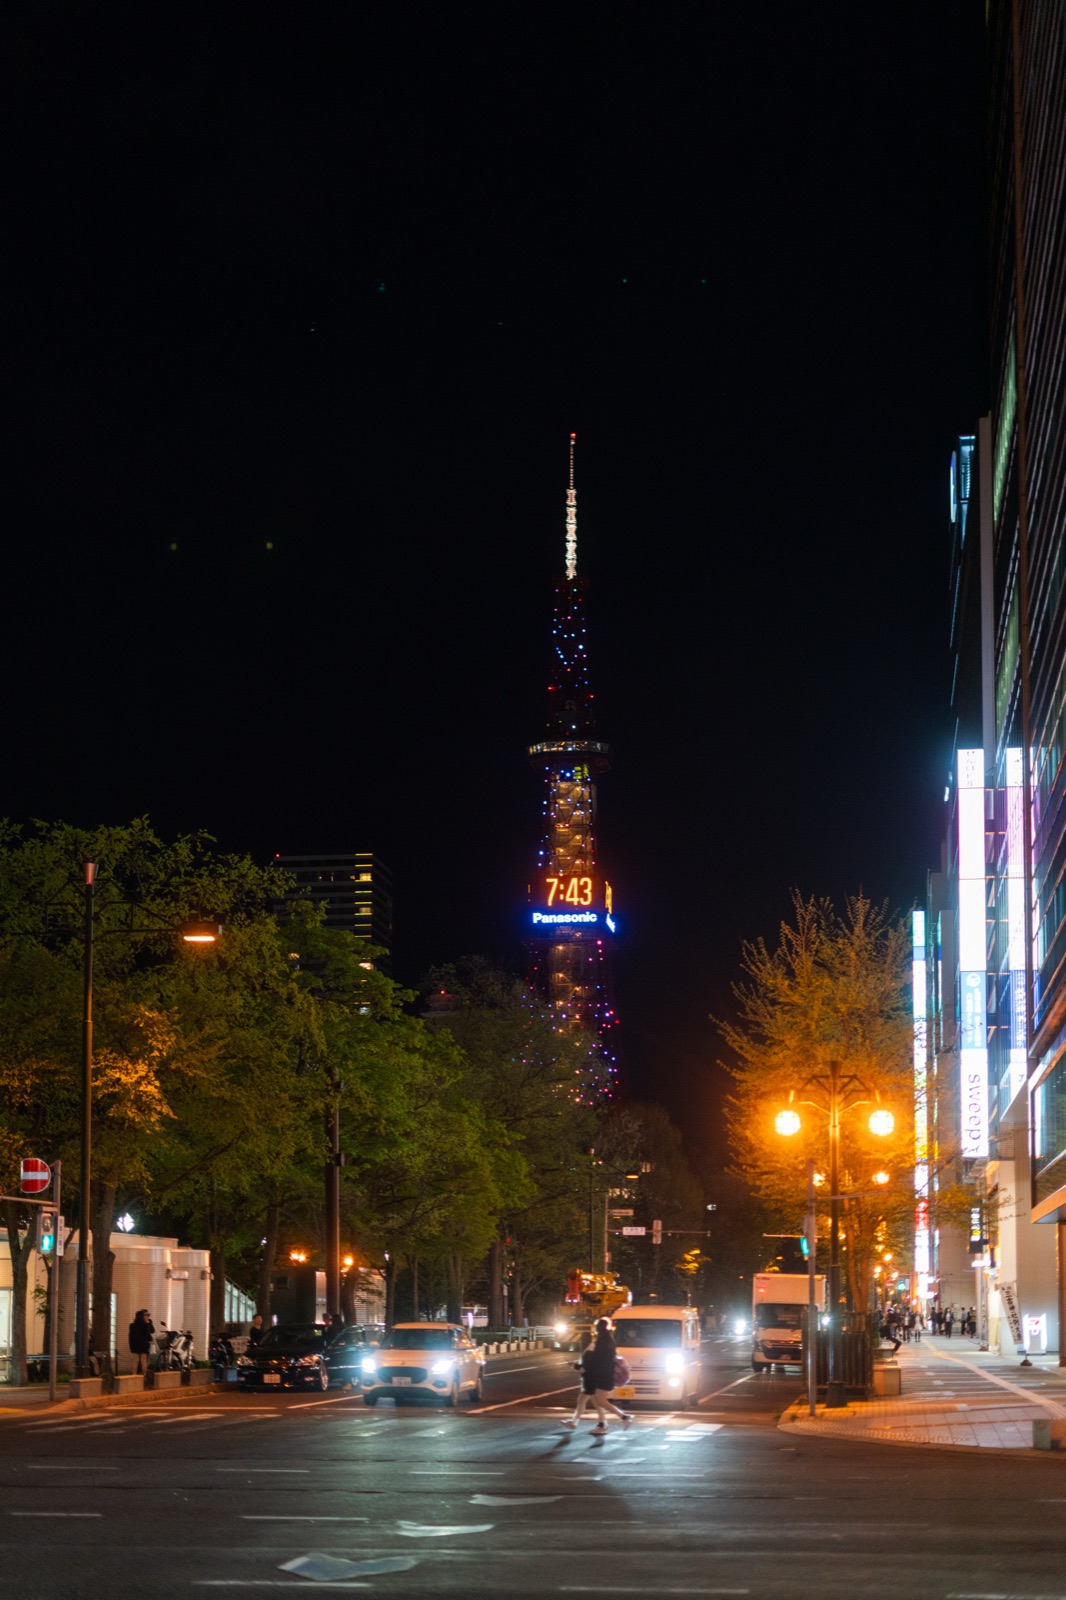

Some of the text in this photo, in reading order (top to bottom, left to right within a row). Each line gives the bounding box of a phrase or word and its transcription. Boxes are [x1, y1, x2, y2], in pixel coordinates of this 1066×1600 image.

[546, 877, 592, 906] 7:43
[533, 912, 598, 923] Panasonic
[965, 1074, 981, 1140] sweep
